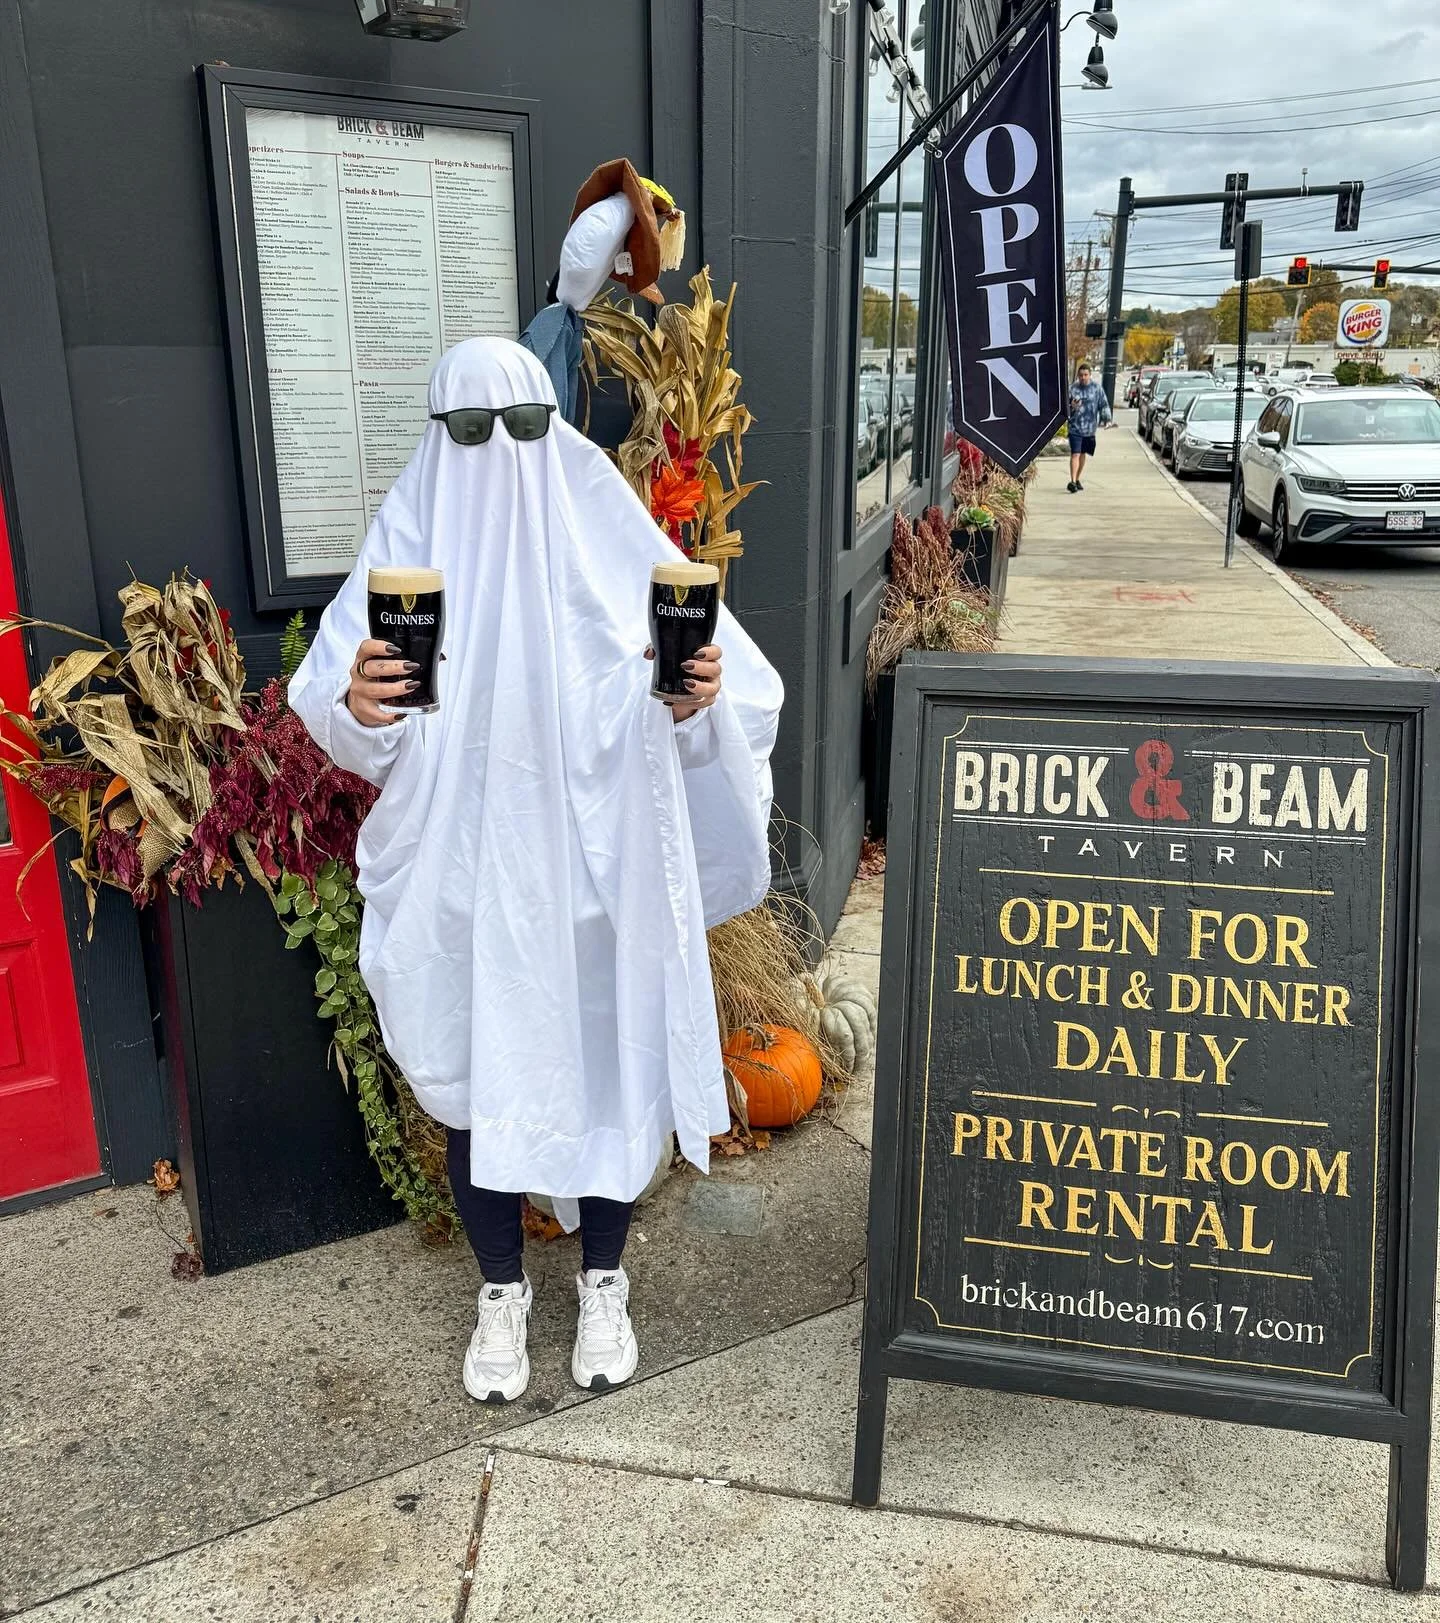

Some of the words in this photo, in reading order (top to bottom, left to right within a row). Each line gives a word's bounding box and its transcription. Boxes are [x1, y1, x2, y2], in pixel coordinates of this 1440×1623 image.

[337, 116, 372, 134] BRICK
[392, 122, 424, 139] BEAM
[248, 145, 284, 153] ppetizers
[357, 137, 410, 147] TAVERN
[342, 151, 365, 160] Soups
[434, 158, 462, 168] Burgers
[470, 162, 509, 171] Sandwiches
[344, 187, 370, 195] Salads
[378, 189, 400, 197] Bowls
[964, 123, 1048, 423] OPEN
[1346, 309, 1381, 325] BURGER
[1346, 318, 1382, 336] KING
[380, 611, 435, 625] GUINNESS
[657, 603, 706, 618] GUINNESS
[953, 750, 1110, 818] BRICK
[1129, 739, 1190, 822] &
[1211, 761, 1370, 834] BEAM
[1038, 835, 1285, 869] TAVERN
[999, 896, 1165, 956] OPEN
[1187, 908, 1318, 969] FOR
[953, 955, 1110, 1007] LUNCH
[1121, 970, 1155, 1011] &
[1166, 973, 1355, 1027] DINNER
[1050, 1021, 1249, 1086] DAILY
[950, 1111, 1169, 1177] PRIVATE
[1182, 1136, 1352, 1198] ROOM
[1017, 1180, 1275, 1256] RENTAL
[602, 1275, 616, 1284] NIKE
[490, 1288, 504, 1296] NIKE
[960, 1273, 1325, 1346] brickandbeam617.com
